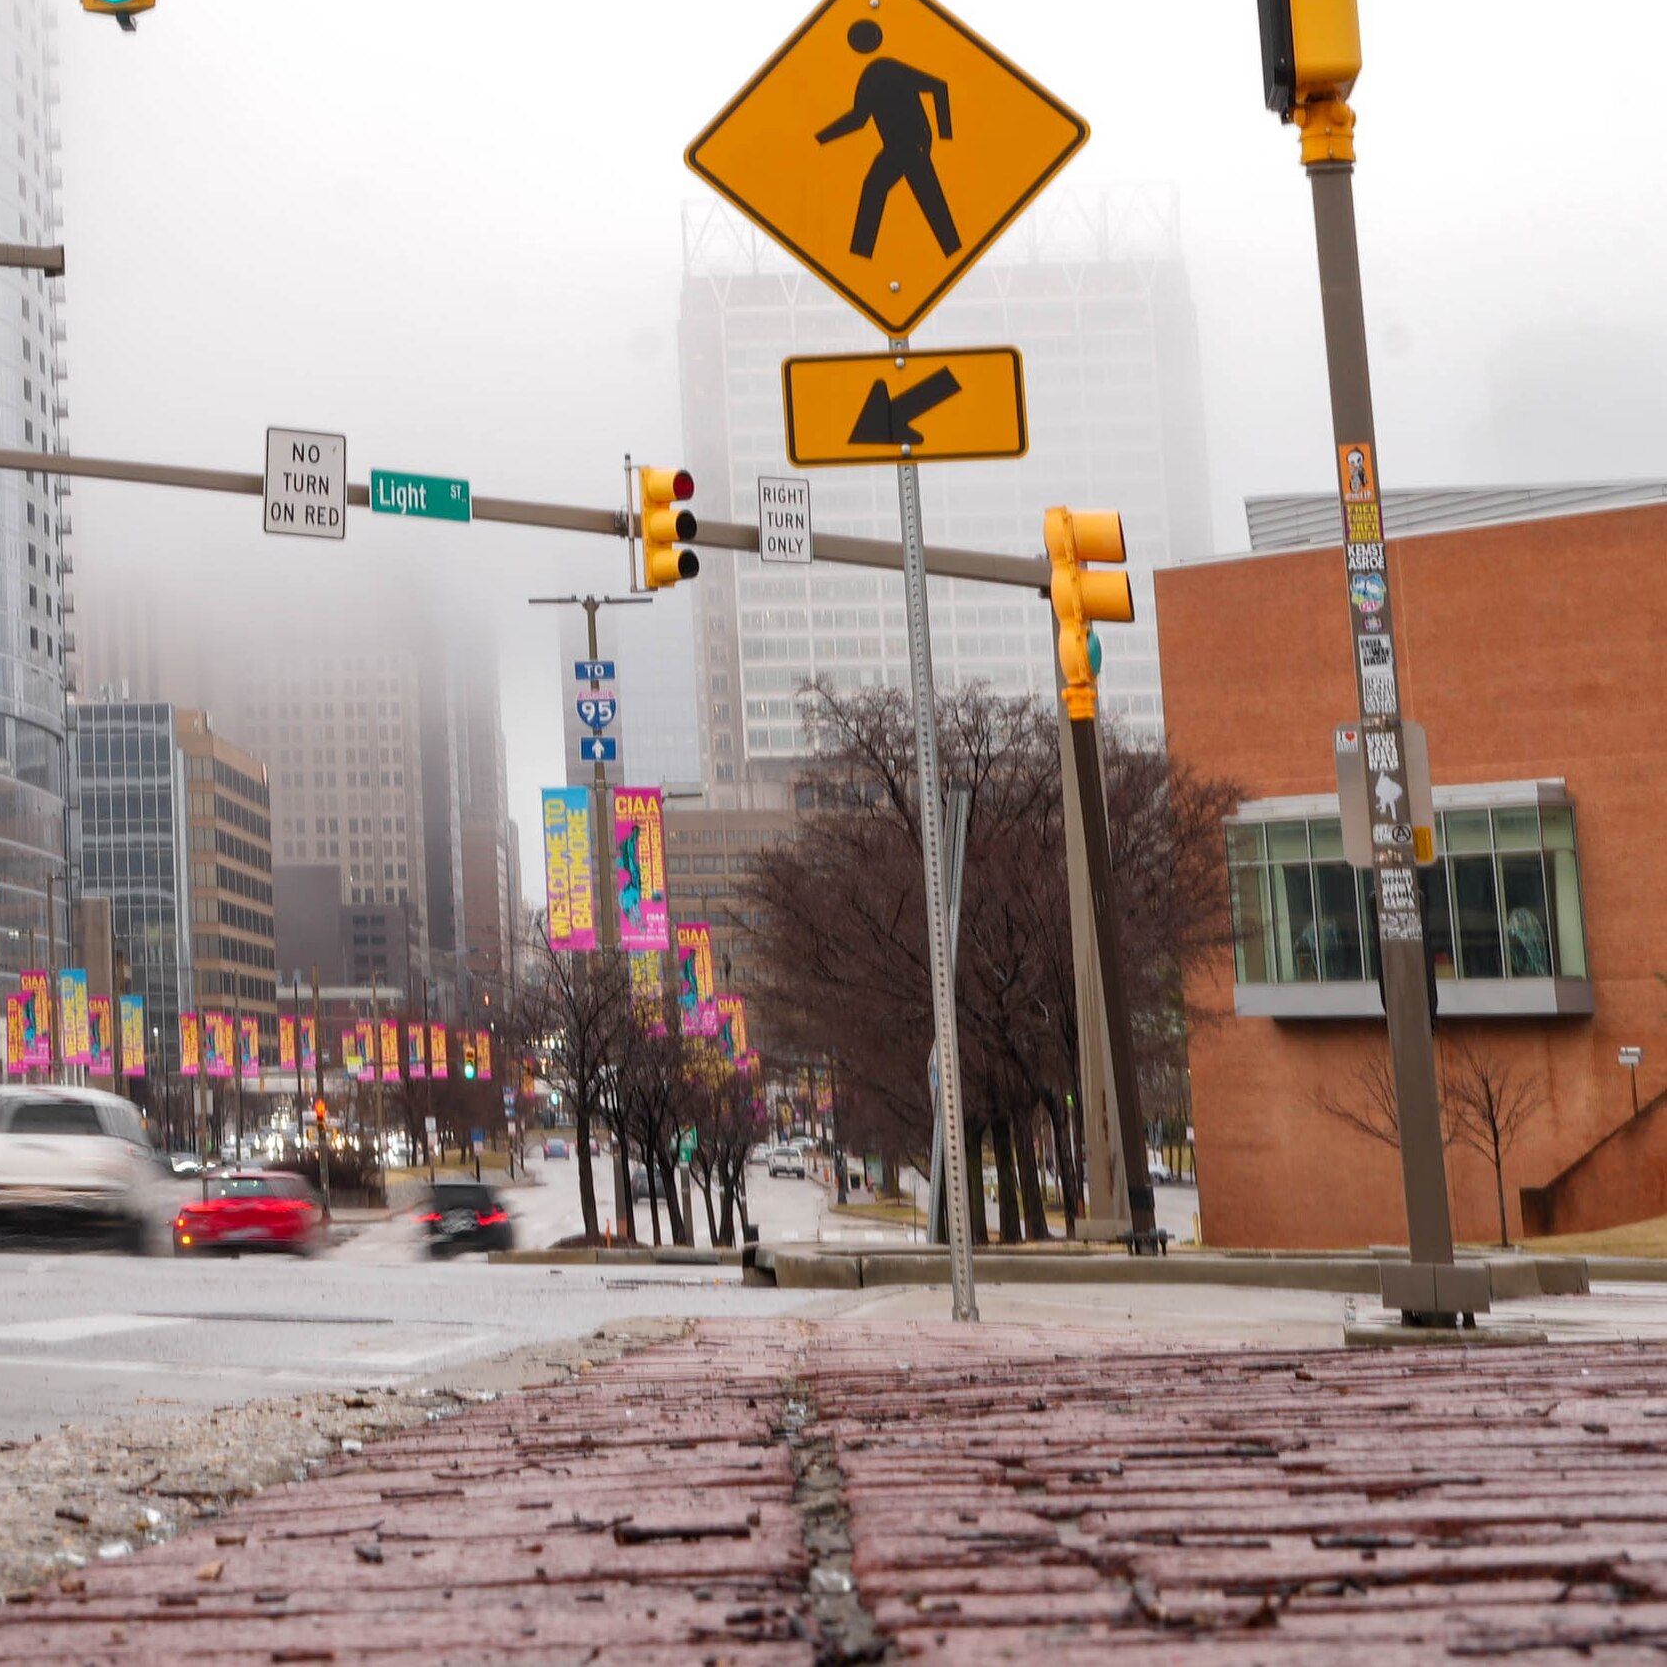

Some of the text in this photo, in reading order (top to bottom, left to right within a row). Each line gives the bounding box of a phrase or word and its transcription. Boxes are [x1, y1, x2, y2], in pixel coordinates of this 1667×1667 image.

[292, 441, 321, 464] NO
[283, 471, 330, 496] TURN
[378, 478, 463, 515] Light ST
[763, 486, 805, 505] RIGHT
[270, 501, 340, 527] ON RED
[767, 511, 805, 530] TURN
[767, 536, 804, 554] ONLY
[584, 663, 605, 678] TO
[581, 700, 613, 722] 95
[614, 796, 660, 814] CIAA
[544, 798, 572, 940] WELCOME TO
[566, 808, 593, 930] BALTIMORE
[678, 927, 709, 943] CIAA
[717, 998, 743, 1013] CIAA
